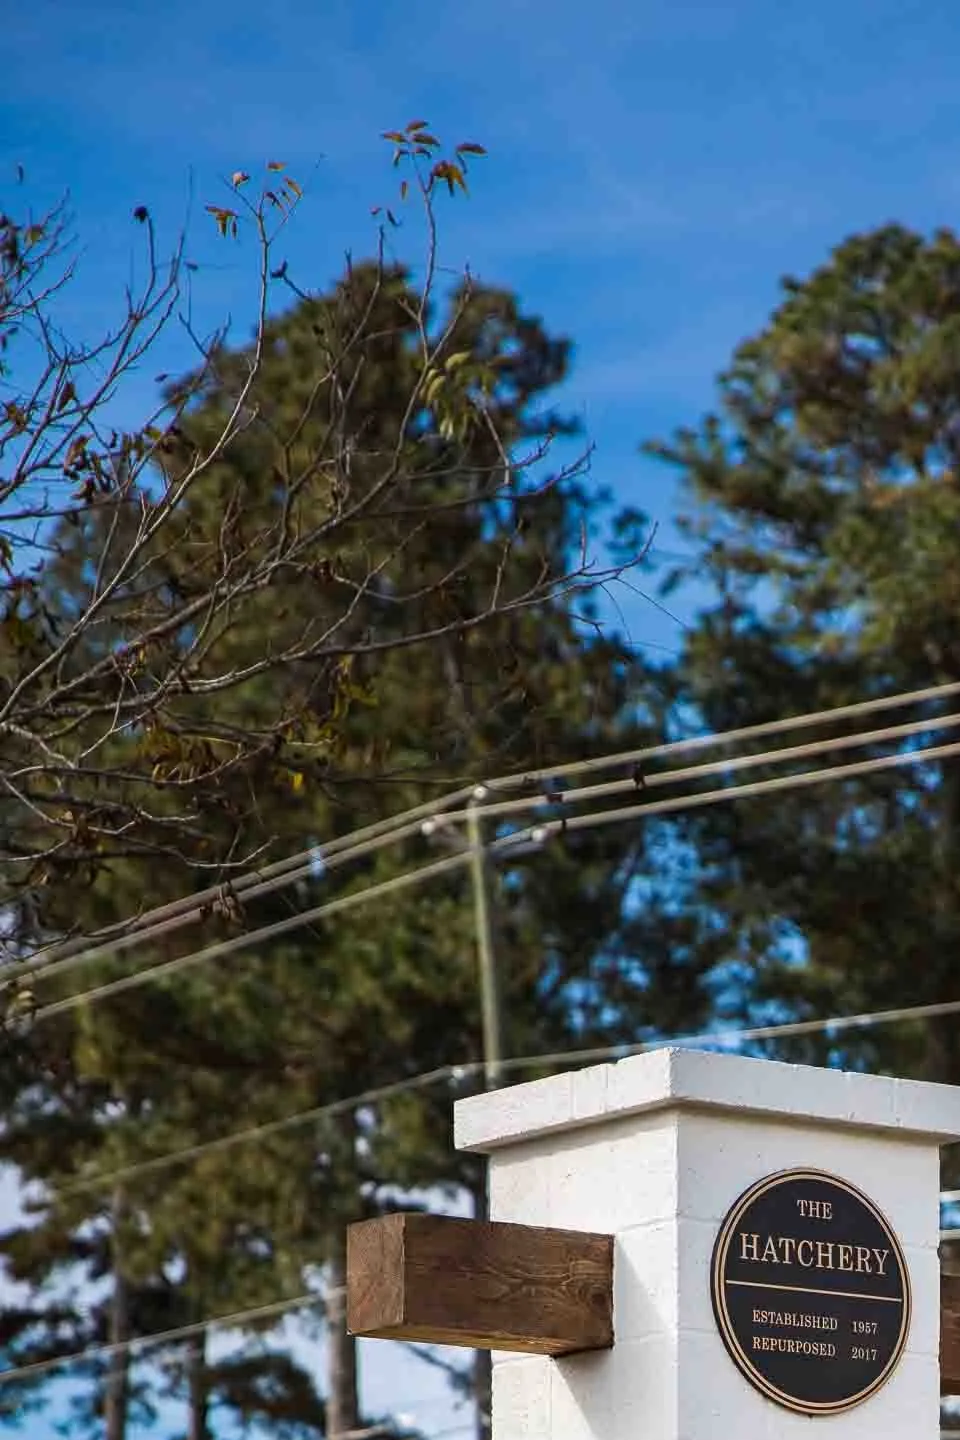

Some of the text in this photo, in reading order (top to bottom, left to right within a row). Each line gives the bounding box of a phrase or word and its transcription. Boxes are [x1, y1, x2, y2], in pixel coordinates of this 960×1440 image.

[797, 1199, 833, 1220] THE
[739, 1232, 890, 1276] HATCHERY
[752, 1309, 878, 1335] ESTABLISHED 1957
[752, 1336, 877, 1361] REPURPOSED 2017
